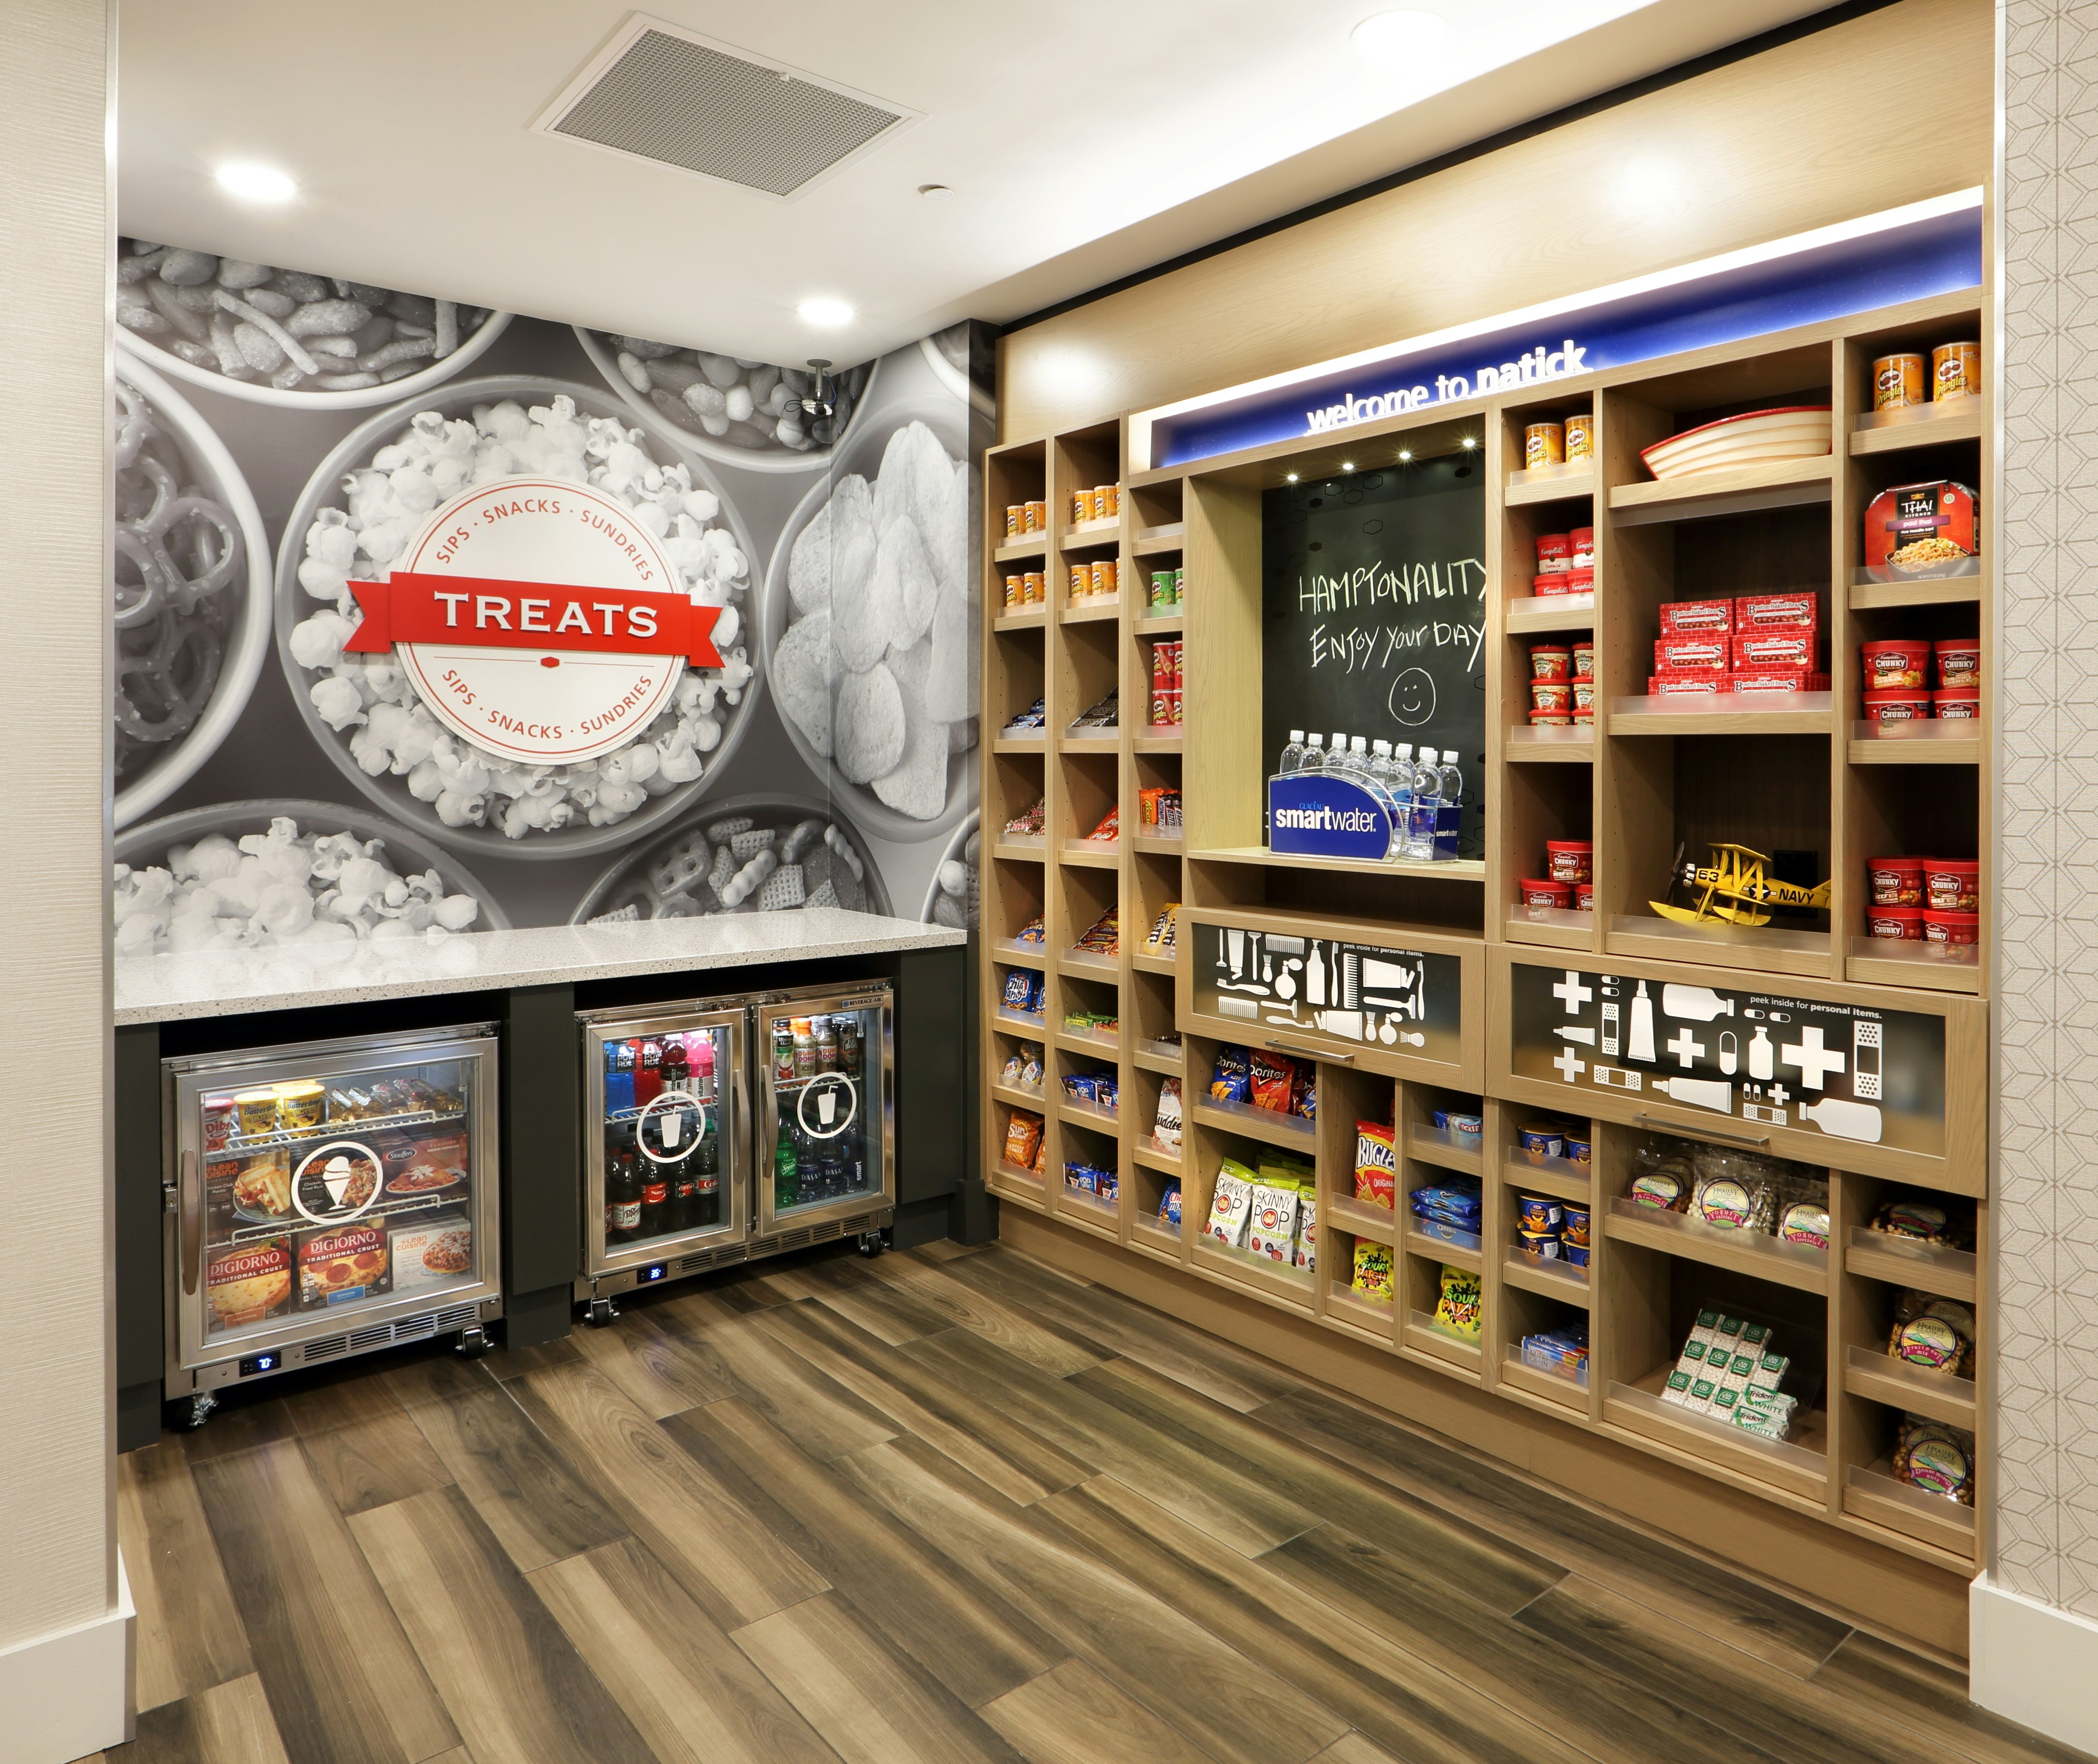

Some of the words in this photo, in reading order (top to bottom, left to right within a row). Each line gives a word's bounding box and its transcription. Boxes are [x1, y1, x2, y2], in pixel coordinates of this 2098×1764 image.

[1307, 385, 1428, 431] welcome
[1435, 375, 1469, 401] to
[1477, 340, 1587, 393] natick
[1937, 376, 1966, 401] Pringles
[1877, 386, 1905, 407] Pringles
[1901, 500, 1933, 513] THAI
[436, 526, 470, 564] SIPS
[483, 499, 561, 524] SNACKS
[580, 510, 654, 581] SUNDRIES
[1300, 558, 1486, 615] HAMPTONALITY
[434, 590, 657, 638] TREATS
[1671, 611, 1691, 620] Boston
[1749, 604, 1769, 614] Boston
[1666, 647, 1687, 657] Boston
[1745, 642, 1767, 653] Boston
[1945, 661, 1974, 669] CHUNKY
[1660, 684, 1681, 694] Boston
[1735, 681, 1757, 691] Boston
[442, 669, 476, 706] SIPS
[487, 710, 563, 739] SNACKS
[580, 675, 652, 735] SUNDRIES
[1299, 801, 1324, 810] GLACÉAU
[1698, 870, 1719, 883] 63
[1931, 881, 1959, 890] CHUNKY
[1779, 888, 1815, 904] NAVY
[1875, 926, 1901, 934] CHUNKY
[1927, 930, 1946, 940] CHUNKY
[1380, 946, 1405, 956] personal
[1750, 995, 1769, 1005] peek
[1771, 998, 1794, 1009] inside
[1796, 1001, 1809, 1010] for
[1810, 1003, 1851, 1017] personal
[1853, 1008, 1882, 1019] items.
[1216, 1055, 1246, 1073] Doritos
[1251, 1064, 1286, 1079] Doritos
[1008, 1123, 1028, 1137] Sun
[1215, 1178, 1246, 1198] SKINNY
[1257, 1191, 1293, 1210] SKINNY
[1253, 1204, 1290, 1231] POP
[1252, 1225, 1288, 1241] POPCORN
[396, 1241, 427, 1251] cuisine
[306, 1250, 355, 1263] TRADITIONAL
[358, 1244, 379, 1253] CRUST
[1362, 1260, 1386, 1272] SOUR
[207, 1272, 257, 1284] TRADITIONAL
[260, 1265, 283, 1274] CRUST
[1357, 1268, 1387, 1282] PATCH
[1445, 1289, 1478, 1305] SOUR
[1443, 1299, 1479, 1317] PATCH
[1749, 1391, 1776, 1400] Trident
[1755, 1401, 1784, 1415] WHITE
[1740, 1413, 1766, 1422] Trident
[1745, 1423, 1774, 1437] WHITE
